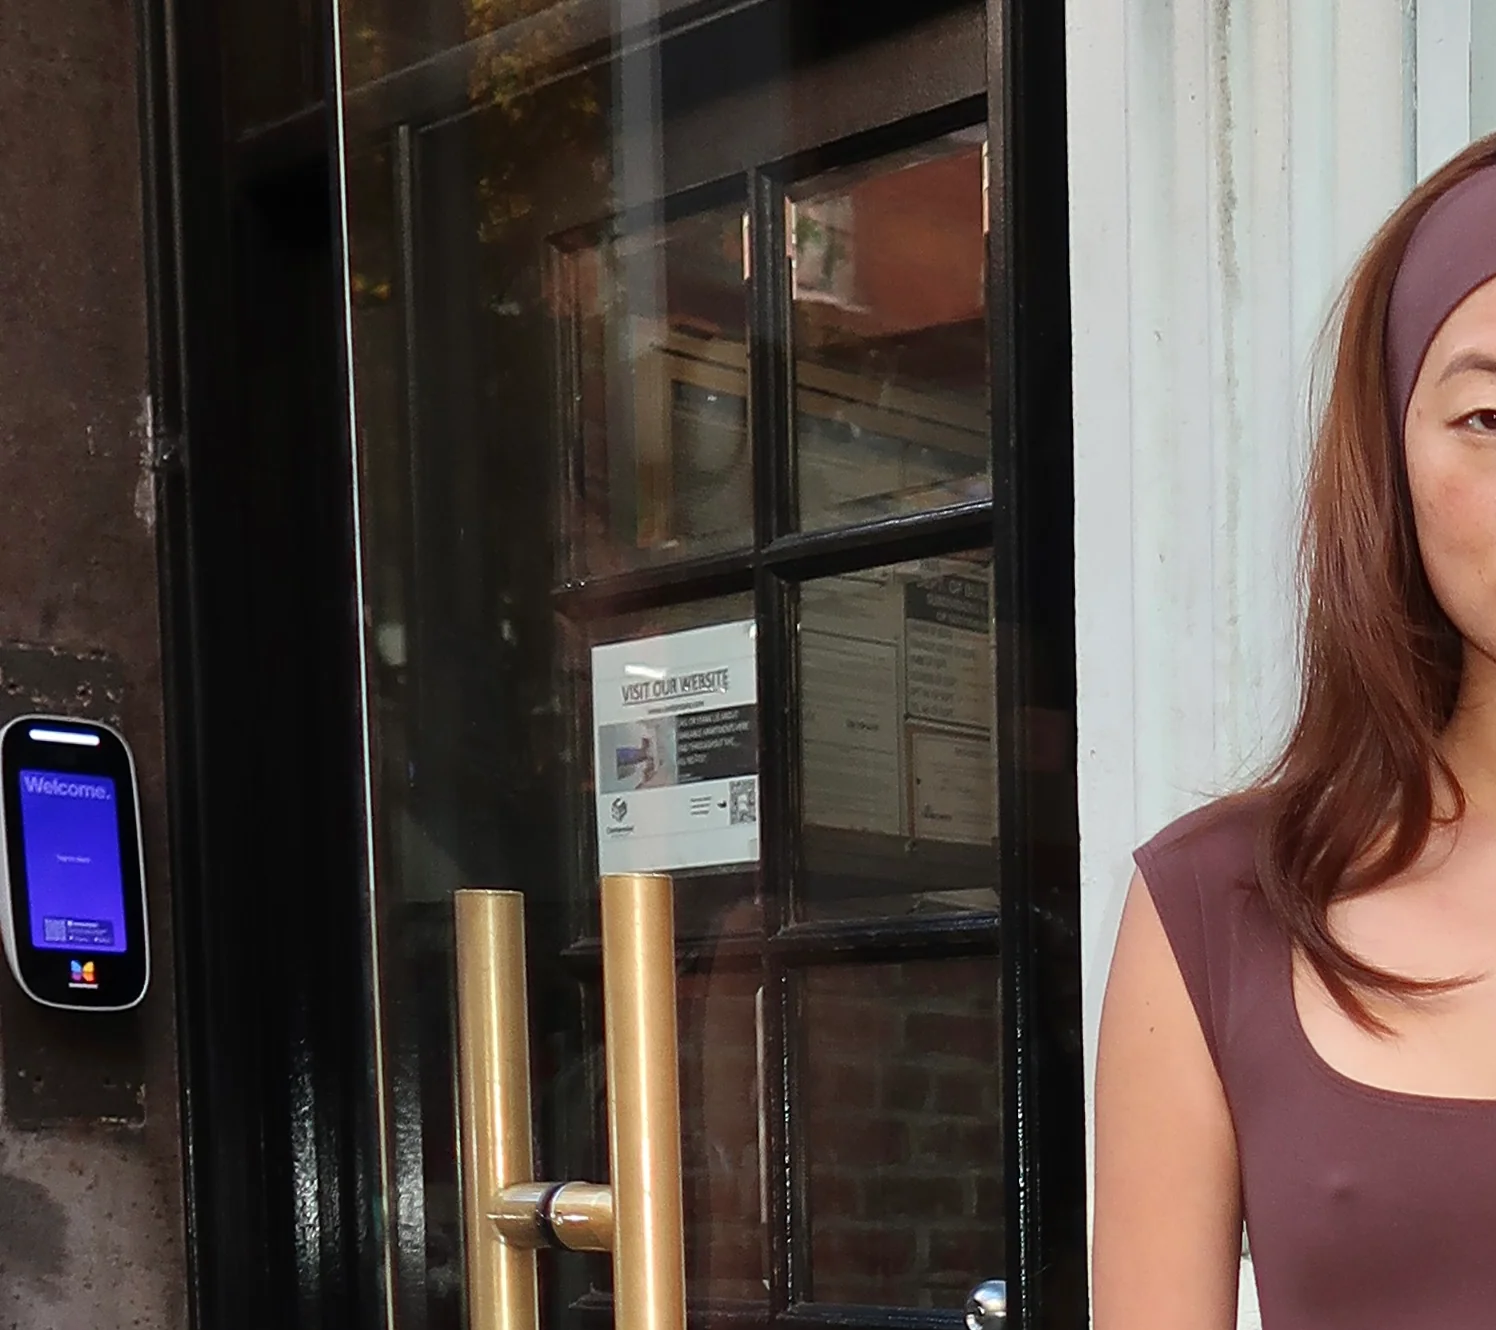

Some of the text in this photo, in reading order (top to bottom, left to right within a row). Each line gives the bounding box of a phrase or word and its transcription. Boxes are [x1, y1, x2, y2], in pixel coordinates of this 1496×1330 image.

[621, 668, 729, 702] VISIT OUR WEBSITE
[24, 775, 111, 800] Welcome.
